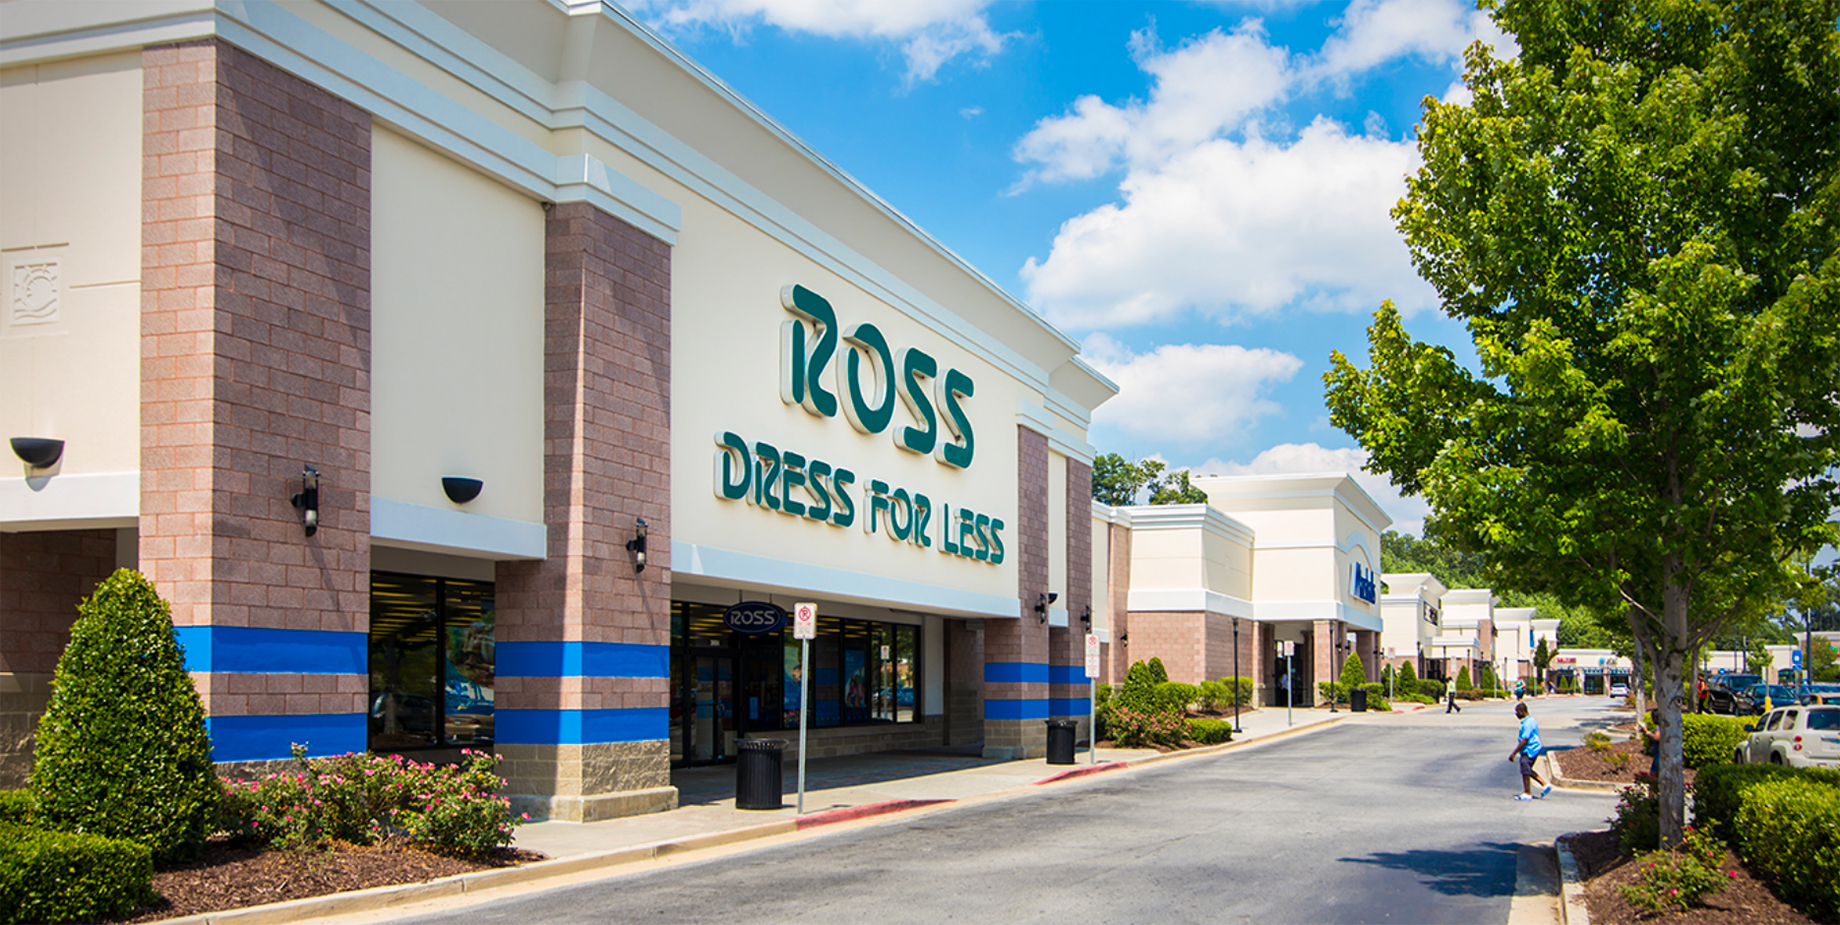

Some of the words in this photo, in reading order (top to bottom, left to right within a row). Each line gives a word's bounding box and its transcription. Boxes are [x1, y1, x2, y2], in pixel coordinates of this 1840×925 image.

[782, 284, 975, 469] ROSS
[715, 431, 855, 528] DRESS
[865, 479, 932, 548] FOR
[939, 503, 1005, 565] LESS
[730, 610, 775, 625] ROSS
